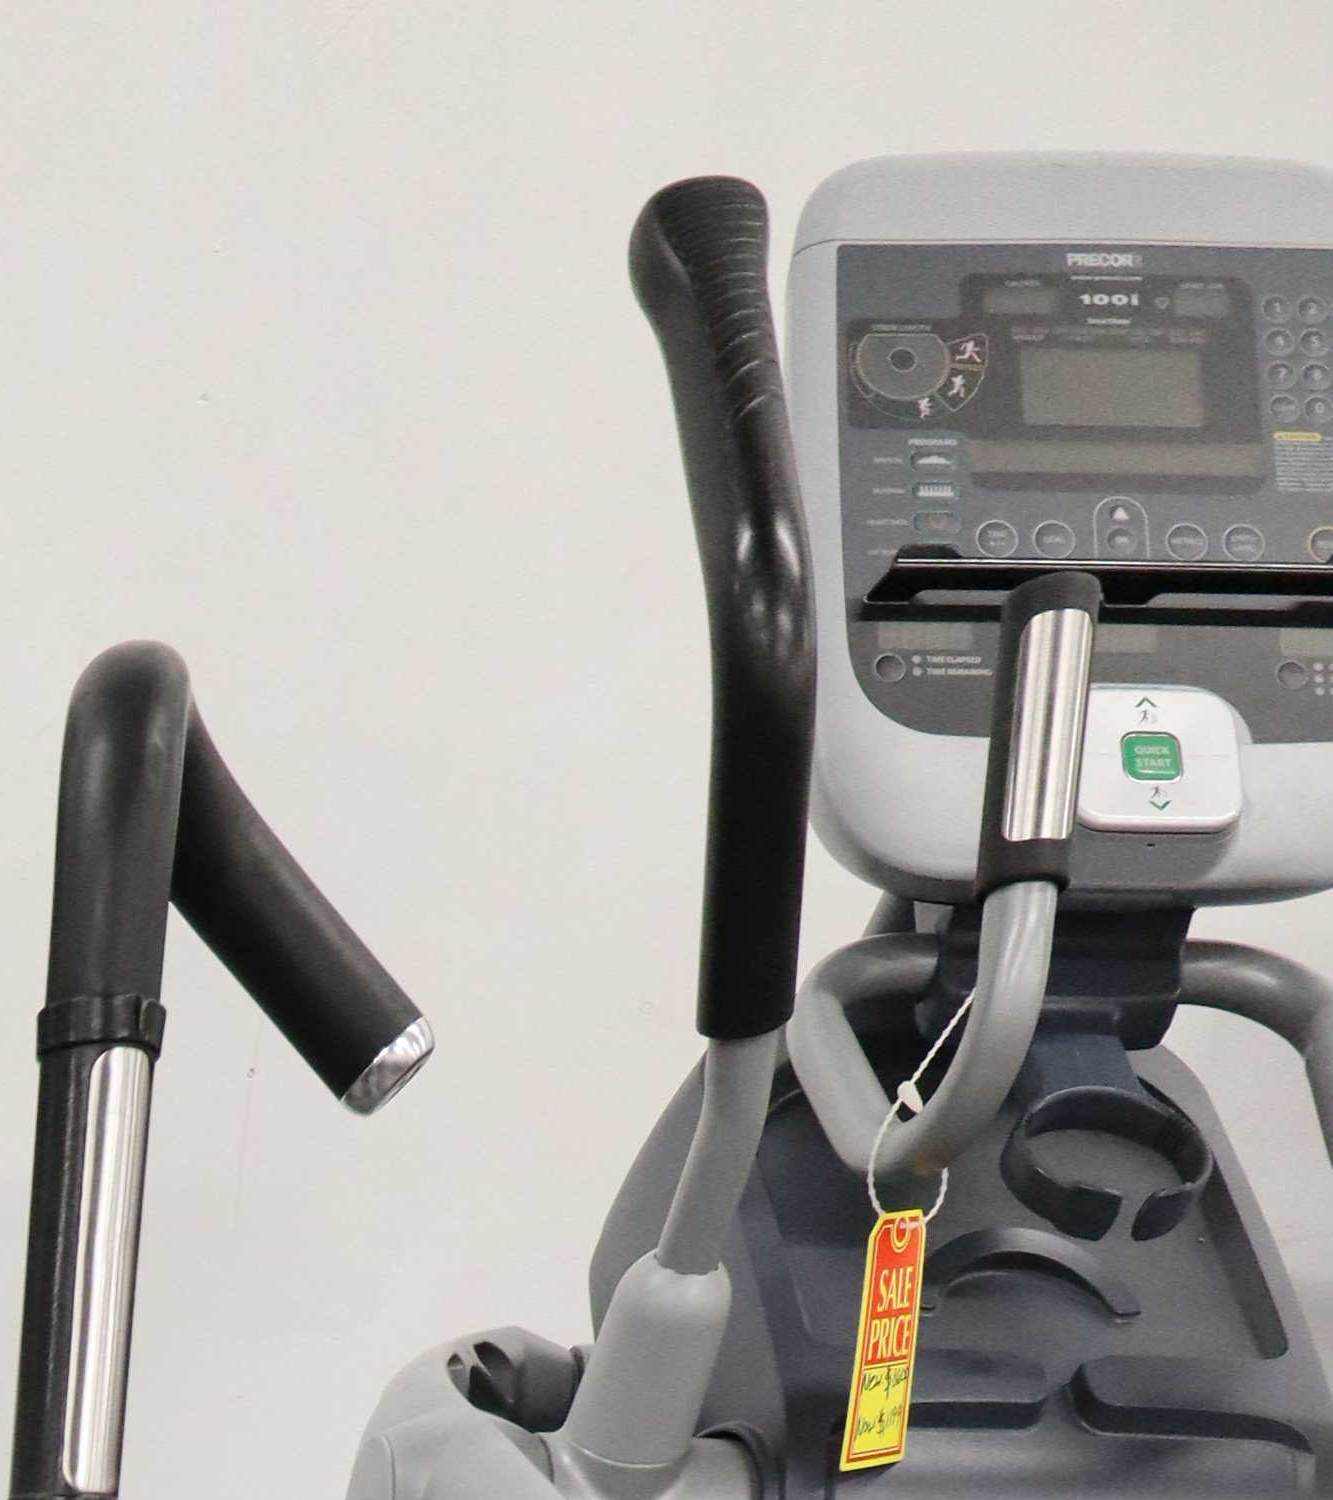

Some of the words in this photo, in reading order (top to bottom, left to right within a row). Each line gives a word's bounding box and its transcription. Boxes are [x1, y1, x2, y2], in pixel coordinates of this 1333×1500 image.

[1066, 253, 1134, 267] PRECOR
[1134, 745, 1170, 755] QUICK
[1136, 758, 1173, 767] START
[877, 1266, 913, 1311] SALE
[868, 1315, 912, 1361] PRICE
